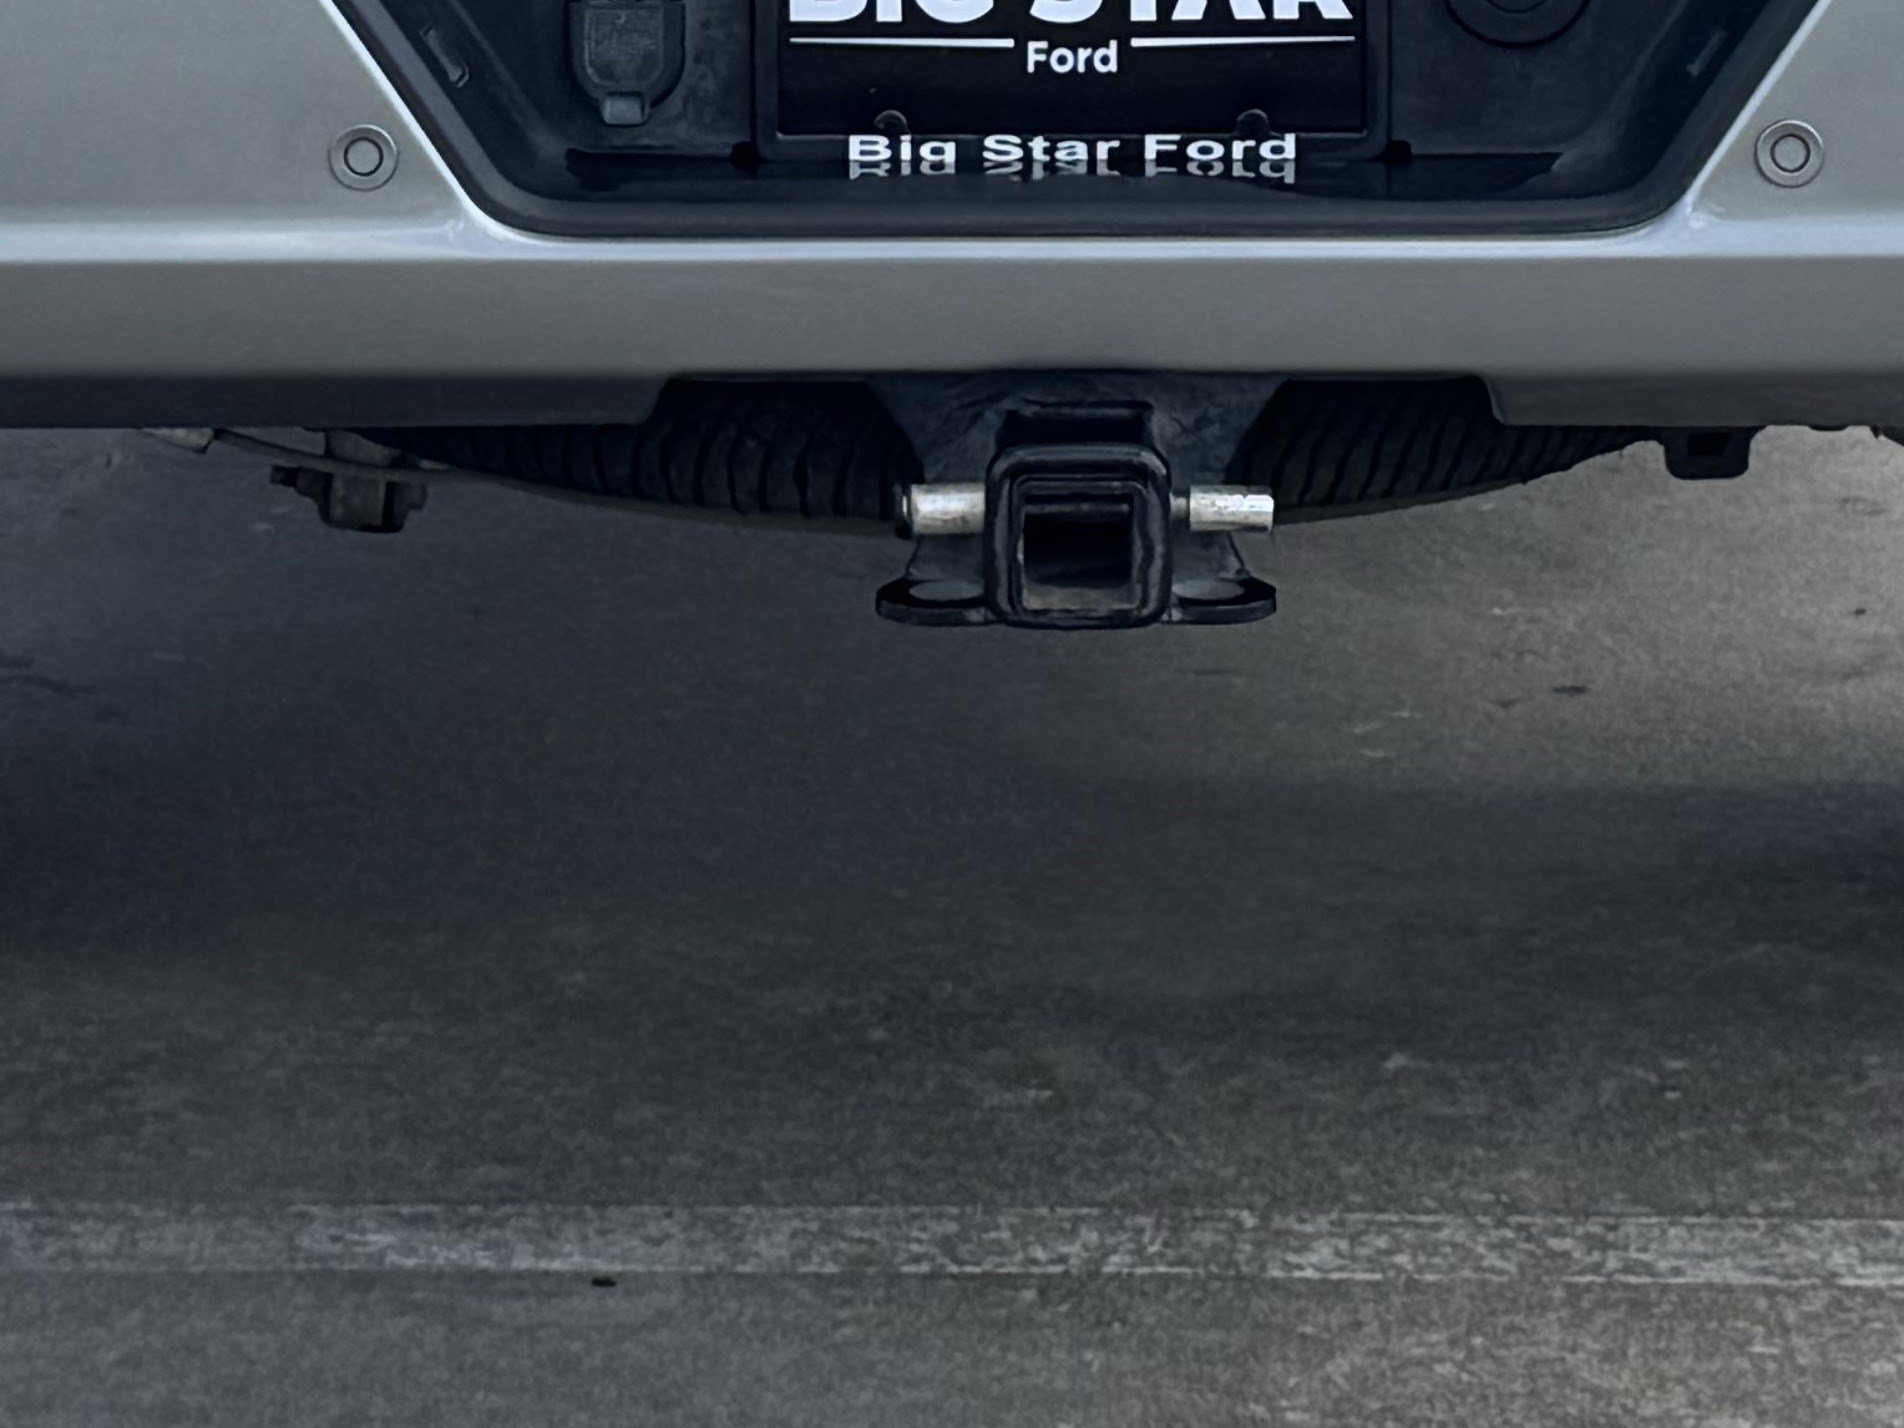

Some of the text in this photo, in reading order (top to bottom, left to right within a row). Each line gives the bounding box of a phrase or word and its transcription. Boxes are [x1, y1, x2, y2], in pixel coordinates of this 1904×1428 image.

[1027, 39, 1118, 74] Ford
[848, 133, 1296, 163] Big Star Ford
